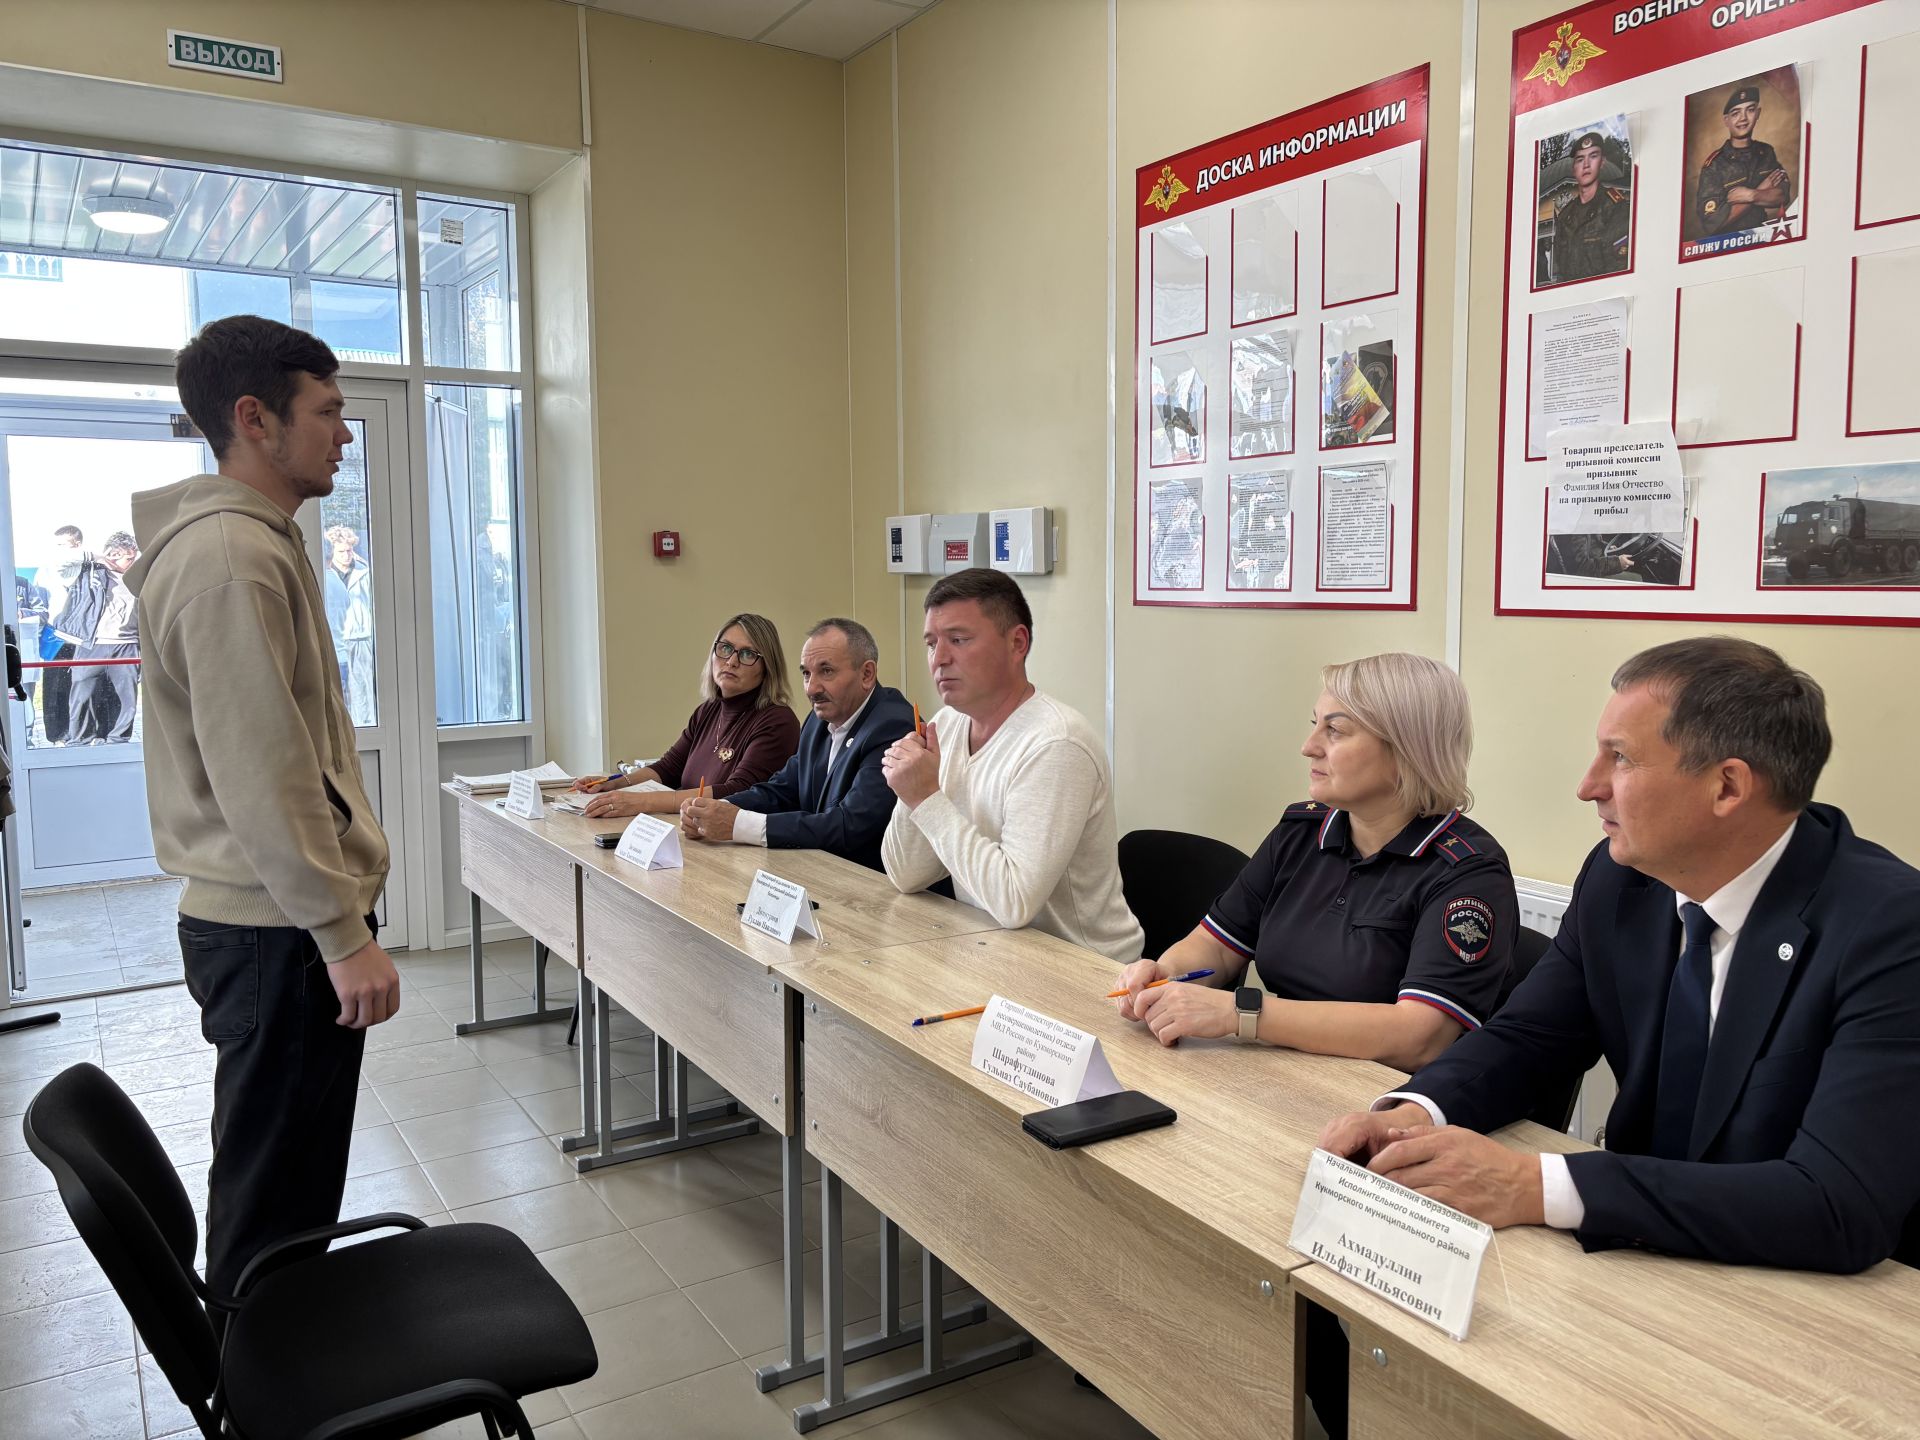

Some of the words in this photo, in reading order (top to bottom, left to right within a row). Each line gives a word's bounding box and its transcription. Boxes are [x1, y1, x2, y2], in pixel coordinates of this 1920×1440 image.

[1613, 0, 1705, 34] ВОЕНН
[1711, 0, 1798, 28] ОРИЕ
[180, 39, 271, 72] ВЫХОД
[1196, 154, 1255, 193] ДОСКА
[1258, 99, 1407, 169] ИНФОРМАЦИИ
[1684, 240, 1720, 256] СЛУЖУ
[1722, 232, 1767, 249] РОССИИ
[1562, 446, 1602, 456] Товарищ
[1604, 442, 1664, 455] председатель
[1565, 457, 1614, 469] призывной
[1616, 455, 1661, 464] комиссии
[1563, 483, 1600, 492] Фамилия
[1602, 481, 1620, 490] Имя
[1622, 480, 1664, 490] Отчество
[1586, 469, 1638, 480] призывник
[1571, 494, 1621, 505] призывную
[1623, 493, 1672, 502] комиссию
[1594, 506, 1629, 516] прибыл
[1449, 899, 1493, 920] ПОЛИЦИЯ
[1451, 910, 1489, 930] РОССИЯ
[1459, 948, 1476, 963] МВД
[992, 1047, 1056, 1087] Шарафутдинова
[1015, 1046, 1037, 1063] району
[983, 1058, 1012, 1082] Гульназ
[1013, 1074, 1060, 1107] Саубановна
[1326, 1155, 1369, 1181] Начальник
[1370, 1176, 1420, 1204] Управления
[1420, 1198, 1479, 1231] образования
[1338, 1176, 1408, 1215] Исполнительного
[1408, 1209, 1450, 1234] комитета
[1315, 1180, 1364, 1210] Кукморского
[1364, 1206, 1441, 1244] муниципального
[1436, 1238, 1471, 1261] района
[1337, 1232, 1423, 1286] Ахмадуллин
[1311, 1240, 1362, 1278] Ильфат
[1364, 1266, 1443, 1321] Ильясович
